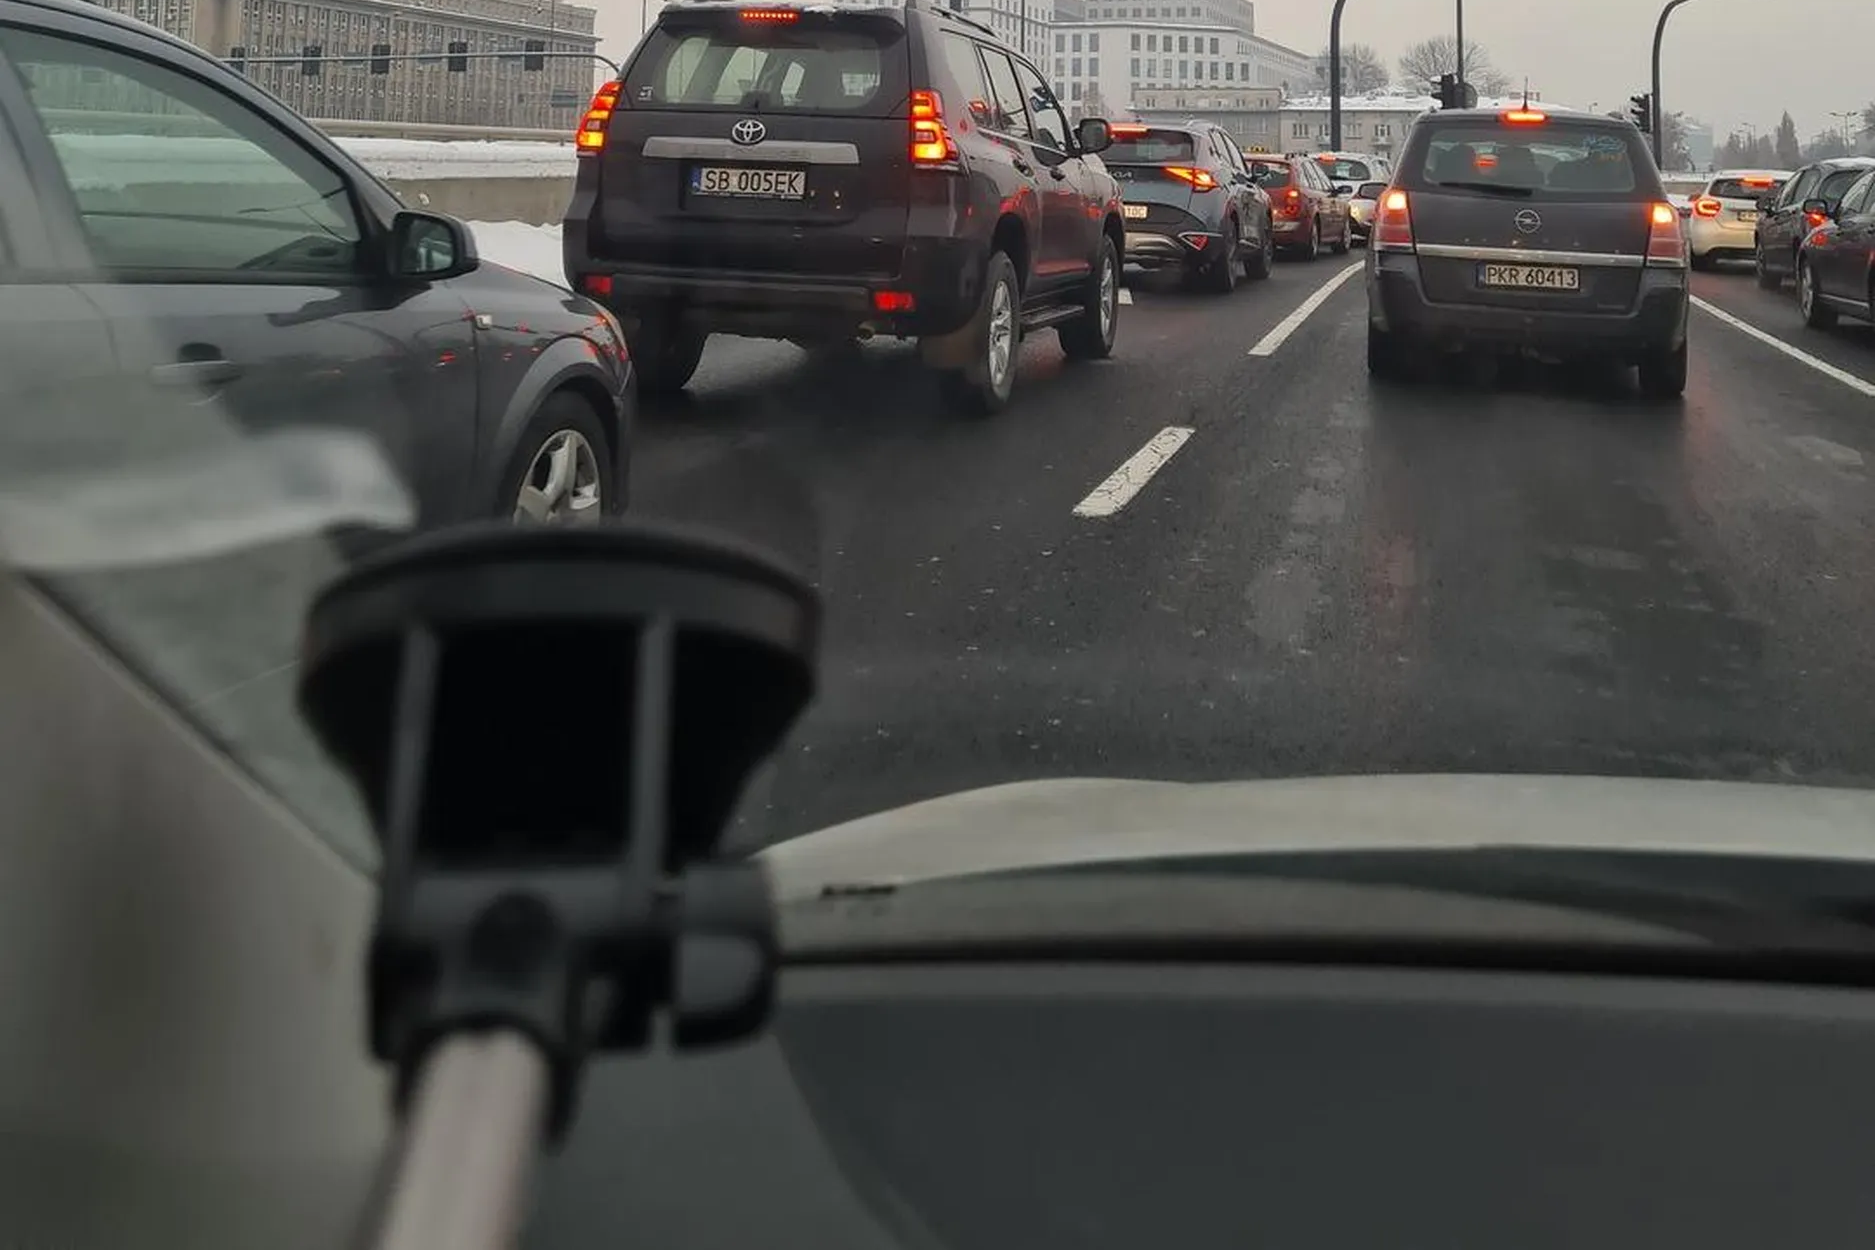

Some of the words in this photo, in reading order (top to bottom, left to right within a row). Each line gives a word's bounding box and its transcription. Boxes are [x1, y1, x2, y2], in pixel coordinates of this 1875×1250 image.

[705, 170, 730, 190] SB
[738, 171, 800, 193] 005EK
[1487, 267, 1519, 284] PKR
[1525, 268, 1576, 287] 60413
